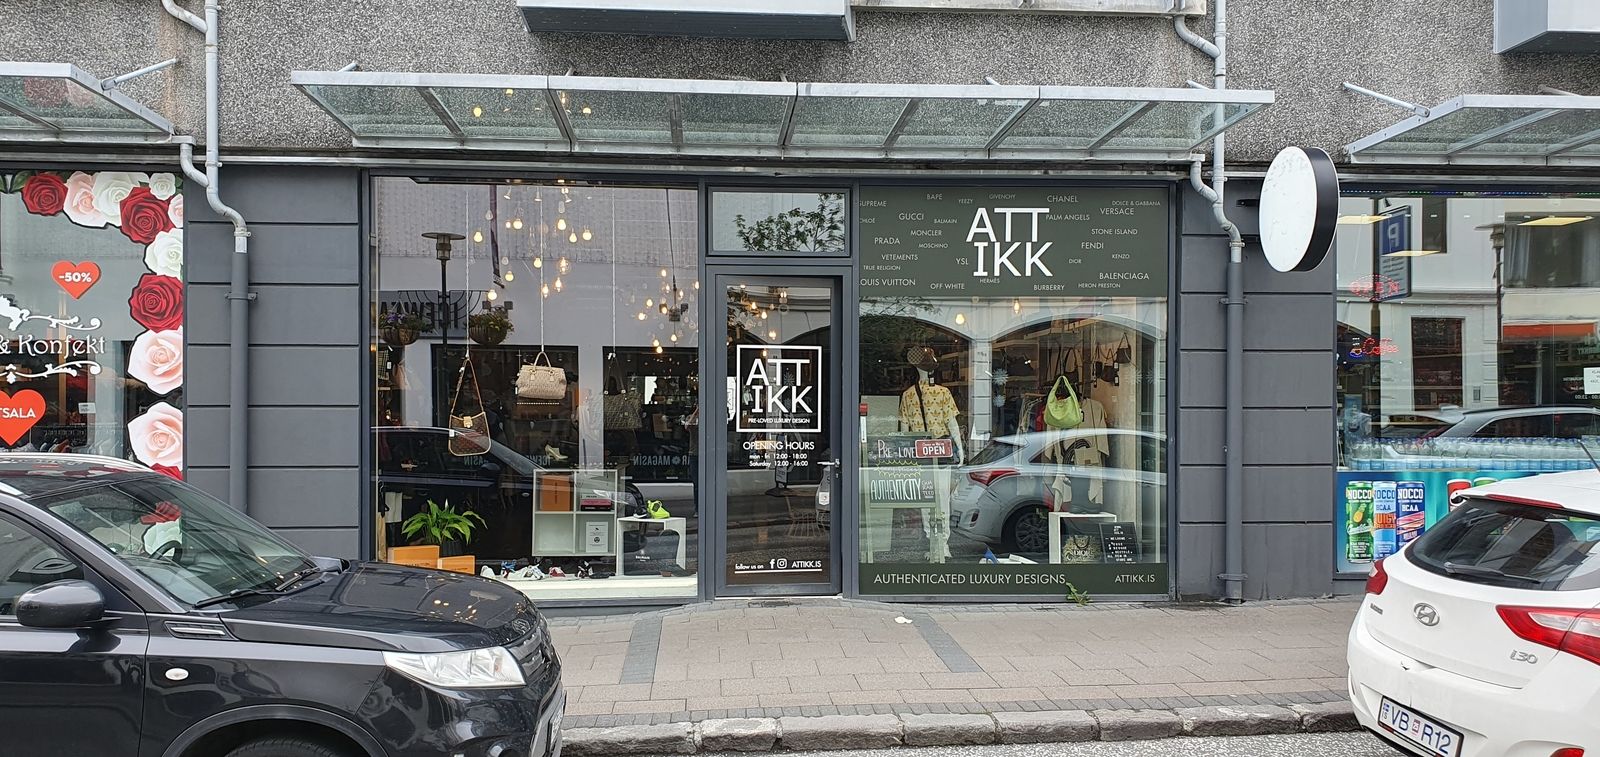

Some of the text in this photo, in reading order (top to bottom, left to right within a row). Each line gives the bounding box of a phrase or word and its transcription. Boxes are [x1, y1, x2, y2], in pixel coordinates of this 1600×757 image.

[1047, 195, 1078, 203] CHANEL
[898, 212, 925, 221] GUCCI
[1100, 207, 1135, 216] VERSACE
[965, 207, 1050, 242] ATT
[910, 229, 942, 237] MONCLER
[874, 236, 901, 245] PRADA
[1081, 241, 1104, 250] FENDI
[881, 253, 919, 261] VETEMENTS
[955, 257, 969, 266] YSL
[973, 241, 1054, 277] IKK
[58, 271, 93, 283] -50%
[1099, 271, 1150, 280] BALENCIAGA
[859, 278, 916, 287] OUIS VUITTON
[930, 282, 965, 290] OFF WHITE
[1033, 283, 1065, 292] BURBERRY
[18, 334, 105, 359] Konfekt
[745, 358, 811, 386] ATT
[751, 385, 813, 413] IKK
[742, 440, 815, 451] OPENING HOURS
[922, 446, 946, 456] OPEN
[870, 478, 922, 501] AUTHENTICITY
[1348, 489, 1372, 500] NOCCO
[1397, 488, 1424, 500] NOCCO
[1401, 504, 1419, 512] BCAA
[791, 560, 822, 569] ATTIKK.IS
[873, 573, 1066, 585] AUTHENTICATED LUXURY DESIGNS
[1114, 574, 1156, 584] ATTIKK.IS
[1509, 650, 1538, 664] i30
[1391, 706, 1410, 732] VB
[1421, 723, 1452, 755] R12
